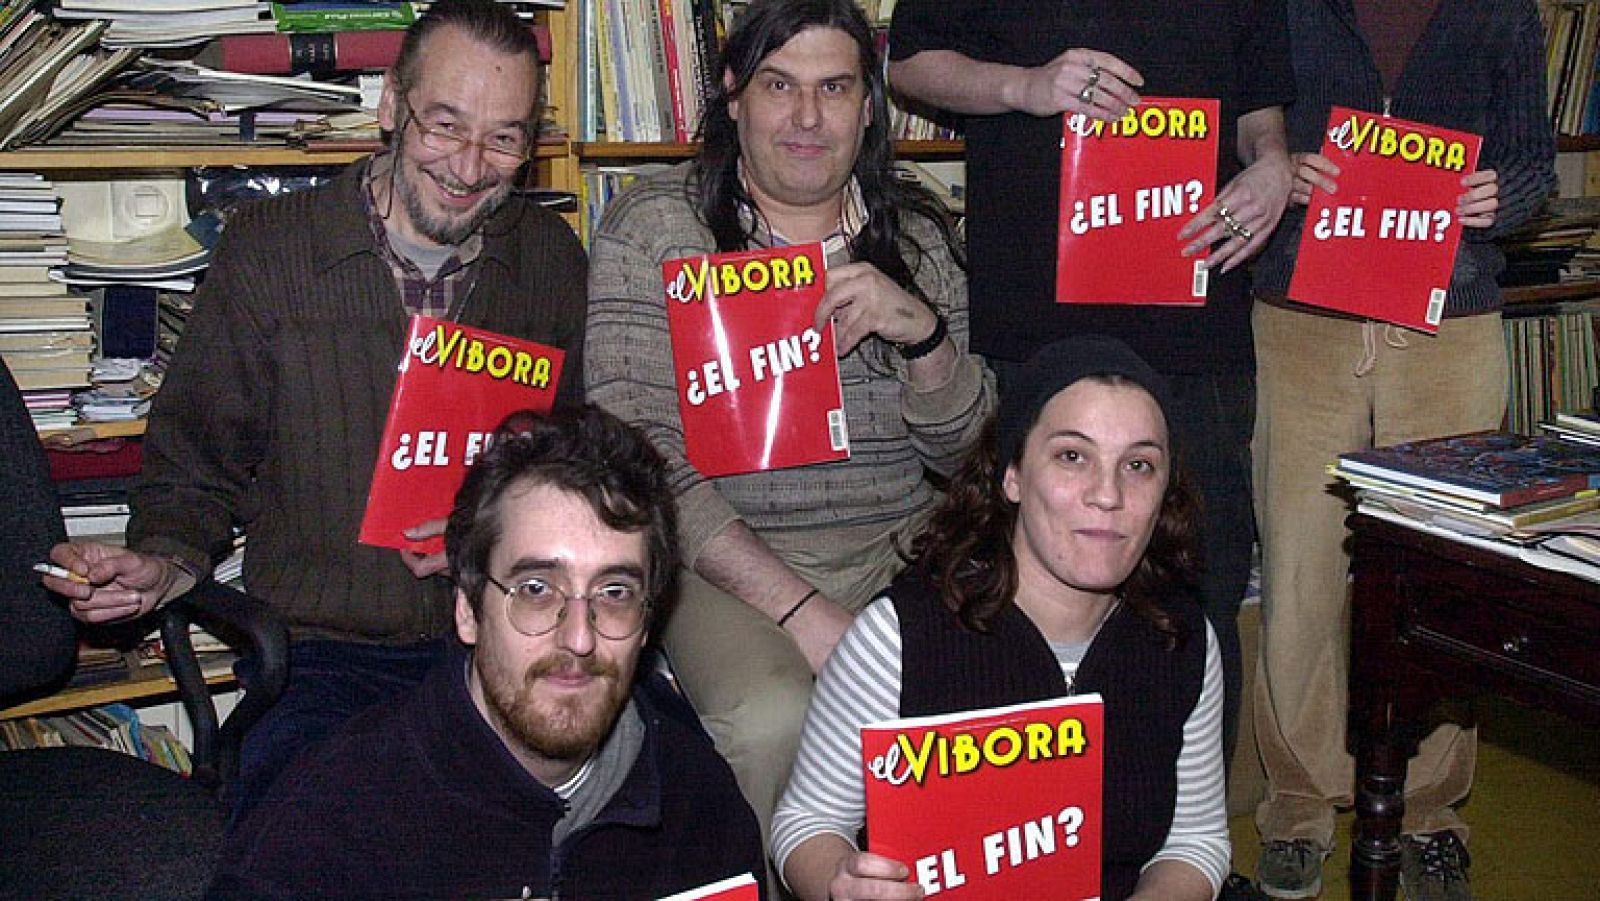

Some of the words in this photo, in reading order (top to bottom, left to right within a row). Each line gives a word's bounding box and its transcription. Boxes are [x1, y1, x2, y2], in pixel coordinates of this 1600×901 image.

[1328, 120, 1355, 149] el
[1351, 115, 1465, 171] VIBORA
[1070, 193, 1123, 235] ¿EL
[1135, 179, 1203, 221] FIN?
[1314, 207, 1366, 240] ¿EL
[1379, 208, 1451, 242] FIN?
[683, 255, 815, 301] VIBORA
[437, 325, 551, 389] VIBORA
[687, 361, 741, 406] ¿EL
[750, 328, 822, 382] FIN?
[391, 431, 449, 470] ¿EL
[868, 742, 913, 785] el
[898, 718, 1087, 783] VIBORA
[982, 806, 1085, 876] FIN?
